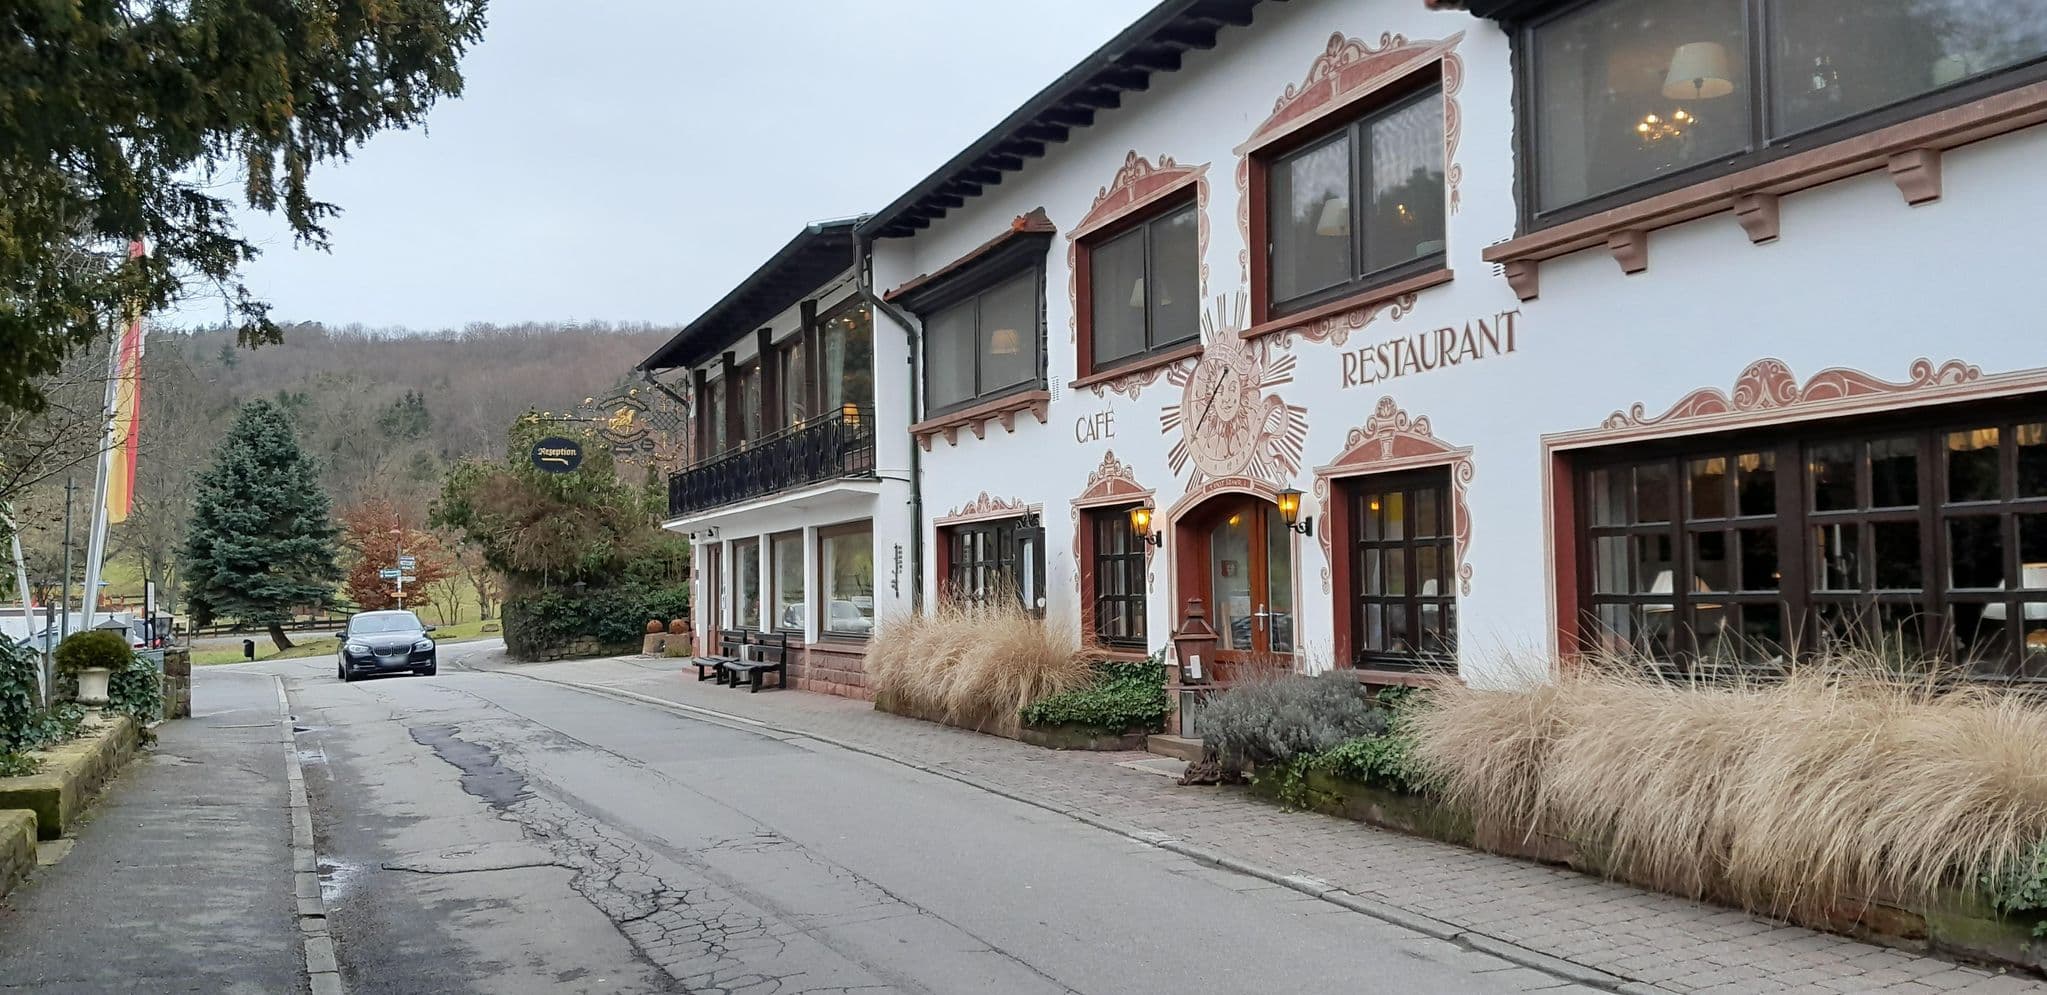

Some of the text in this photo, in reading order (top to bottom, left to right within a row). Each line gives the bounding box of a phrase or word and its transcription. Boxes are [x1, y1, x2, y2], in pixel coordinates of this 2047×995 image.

[1341, 307, 1521, 389] RESTAURANT
[1075, 400, 1115, 444] CAFÉ
[537, 447, 577, 457] Rezeption
